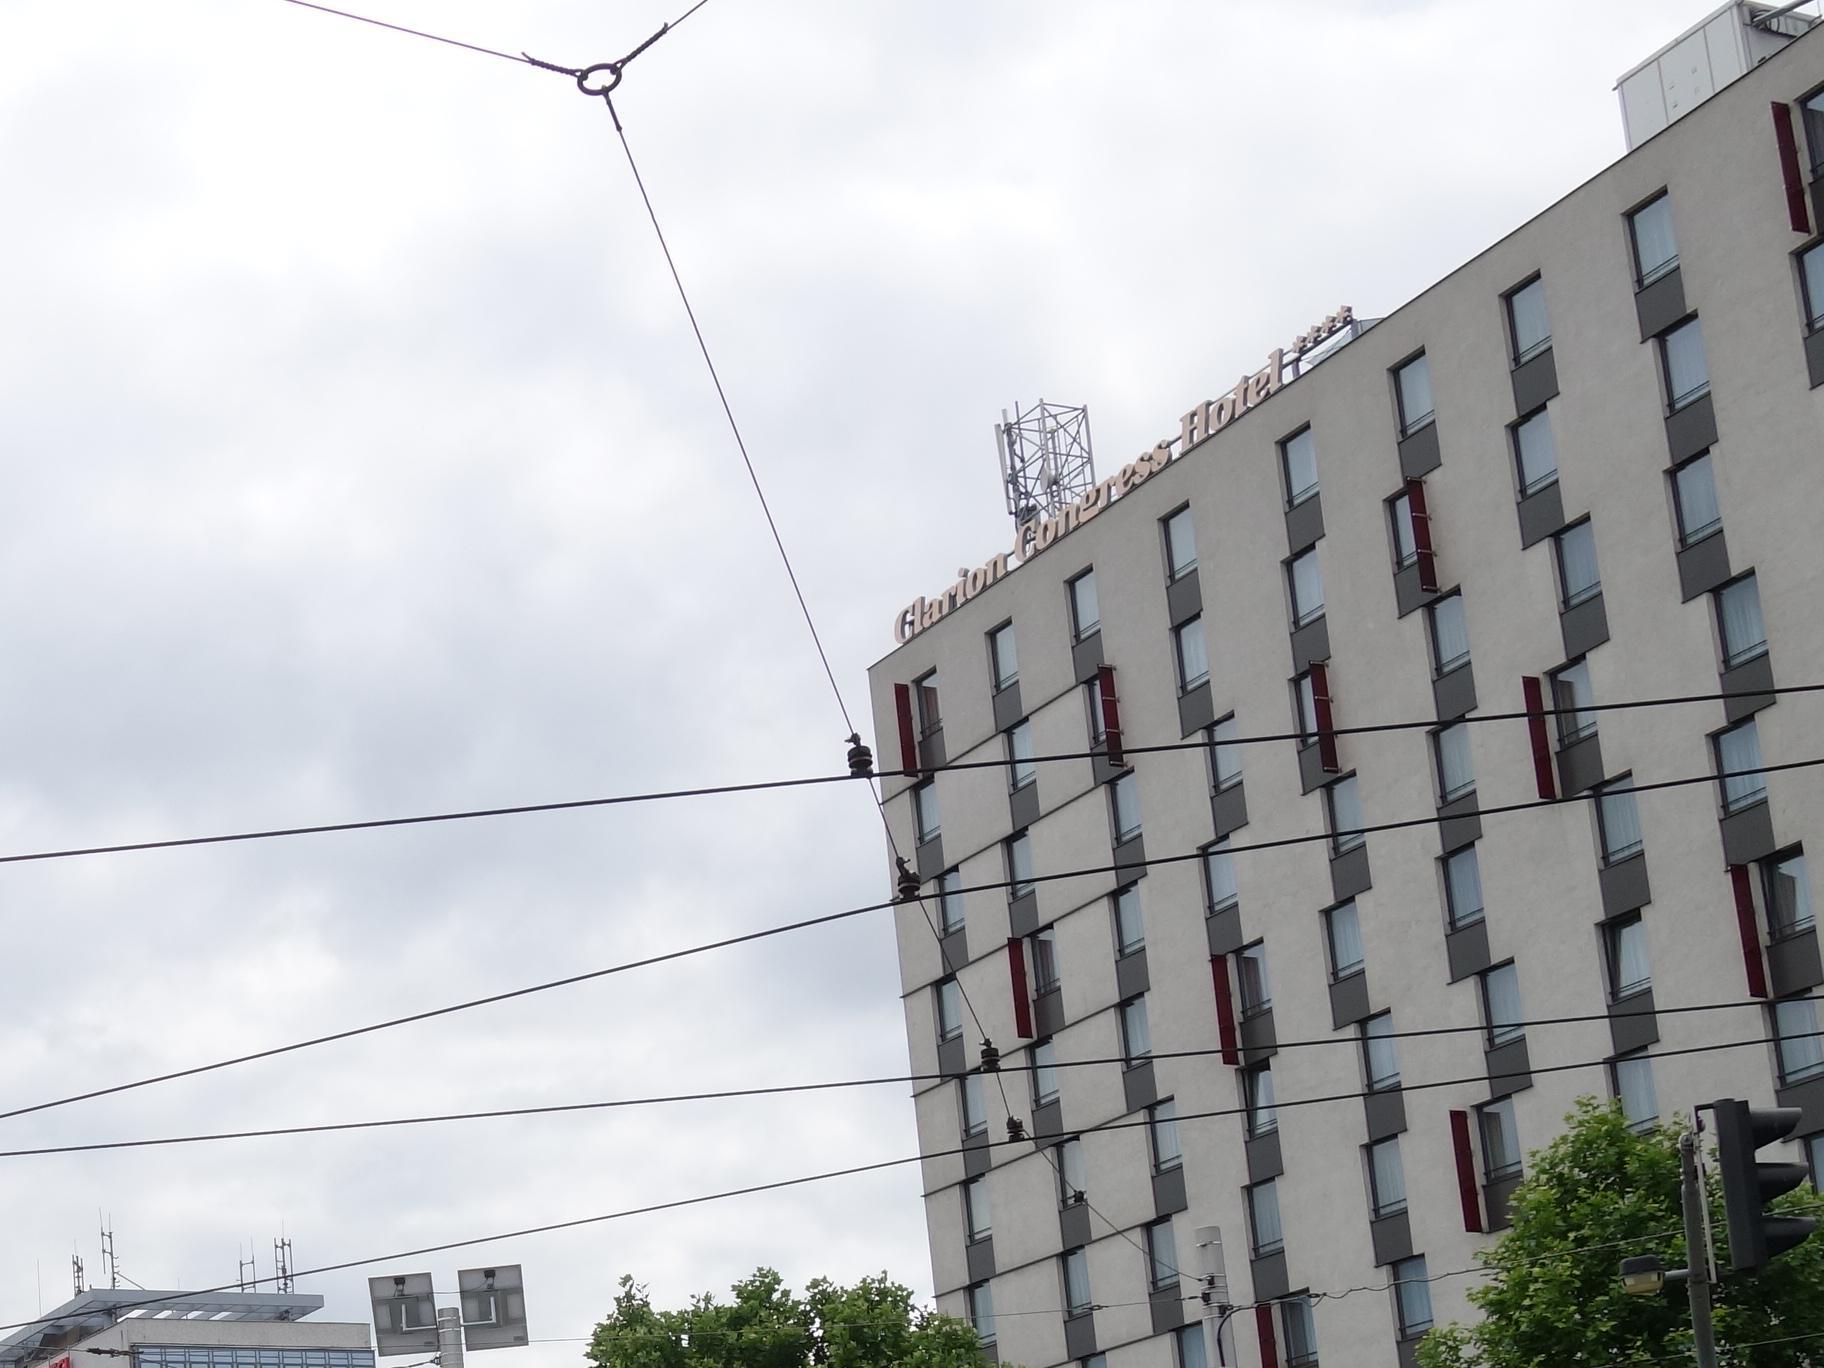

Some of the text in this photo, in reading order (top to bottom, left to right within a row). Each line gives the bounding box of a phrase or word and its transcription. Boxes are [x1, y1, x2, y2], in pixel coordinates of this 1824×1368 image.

[894, 348, 1284, 644] Clarion Congress Hotel
